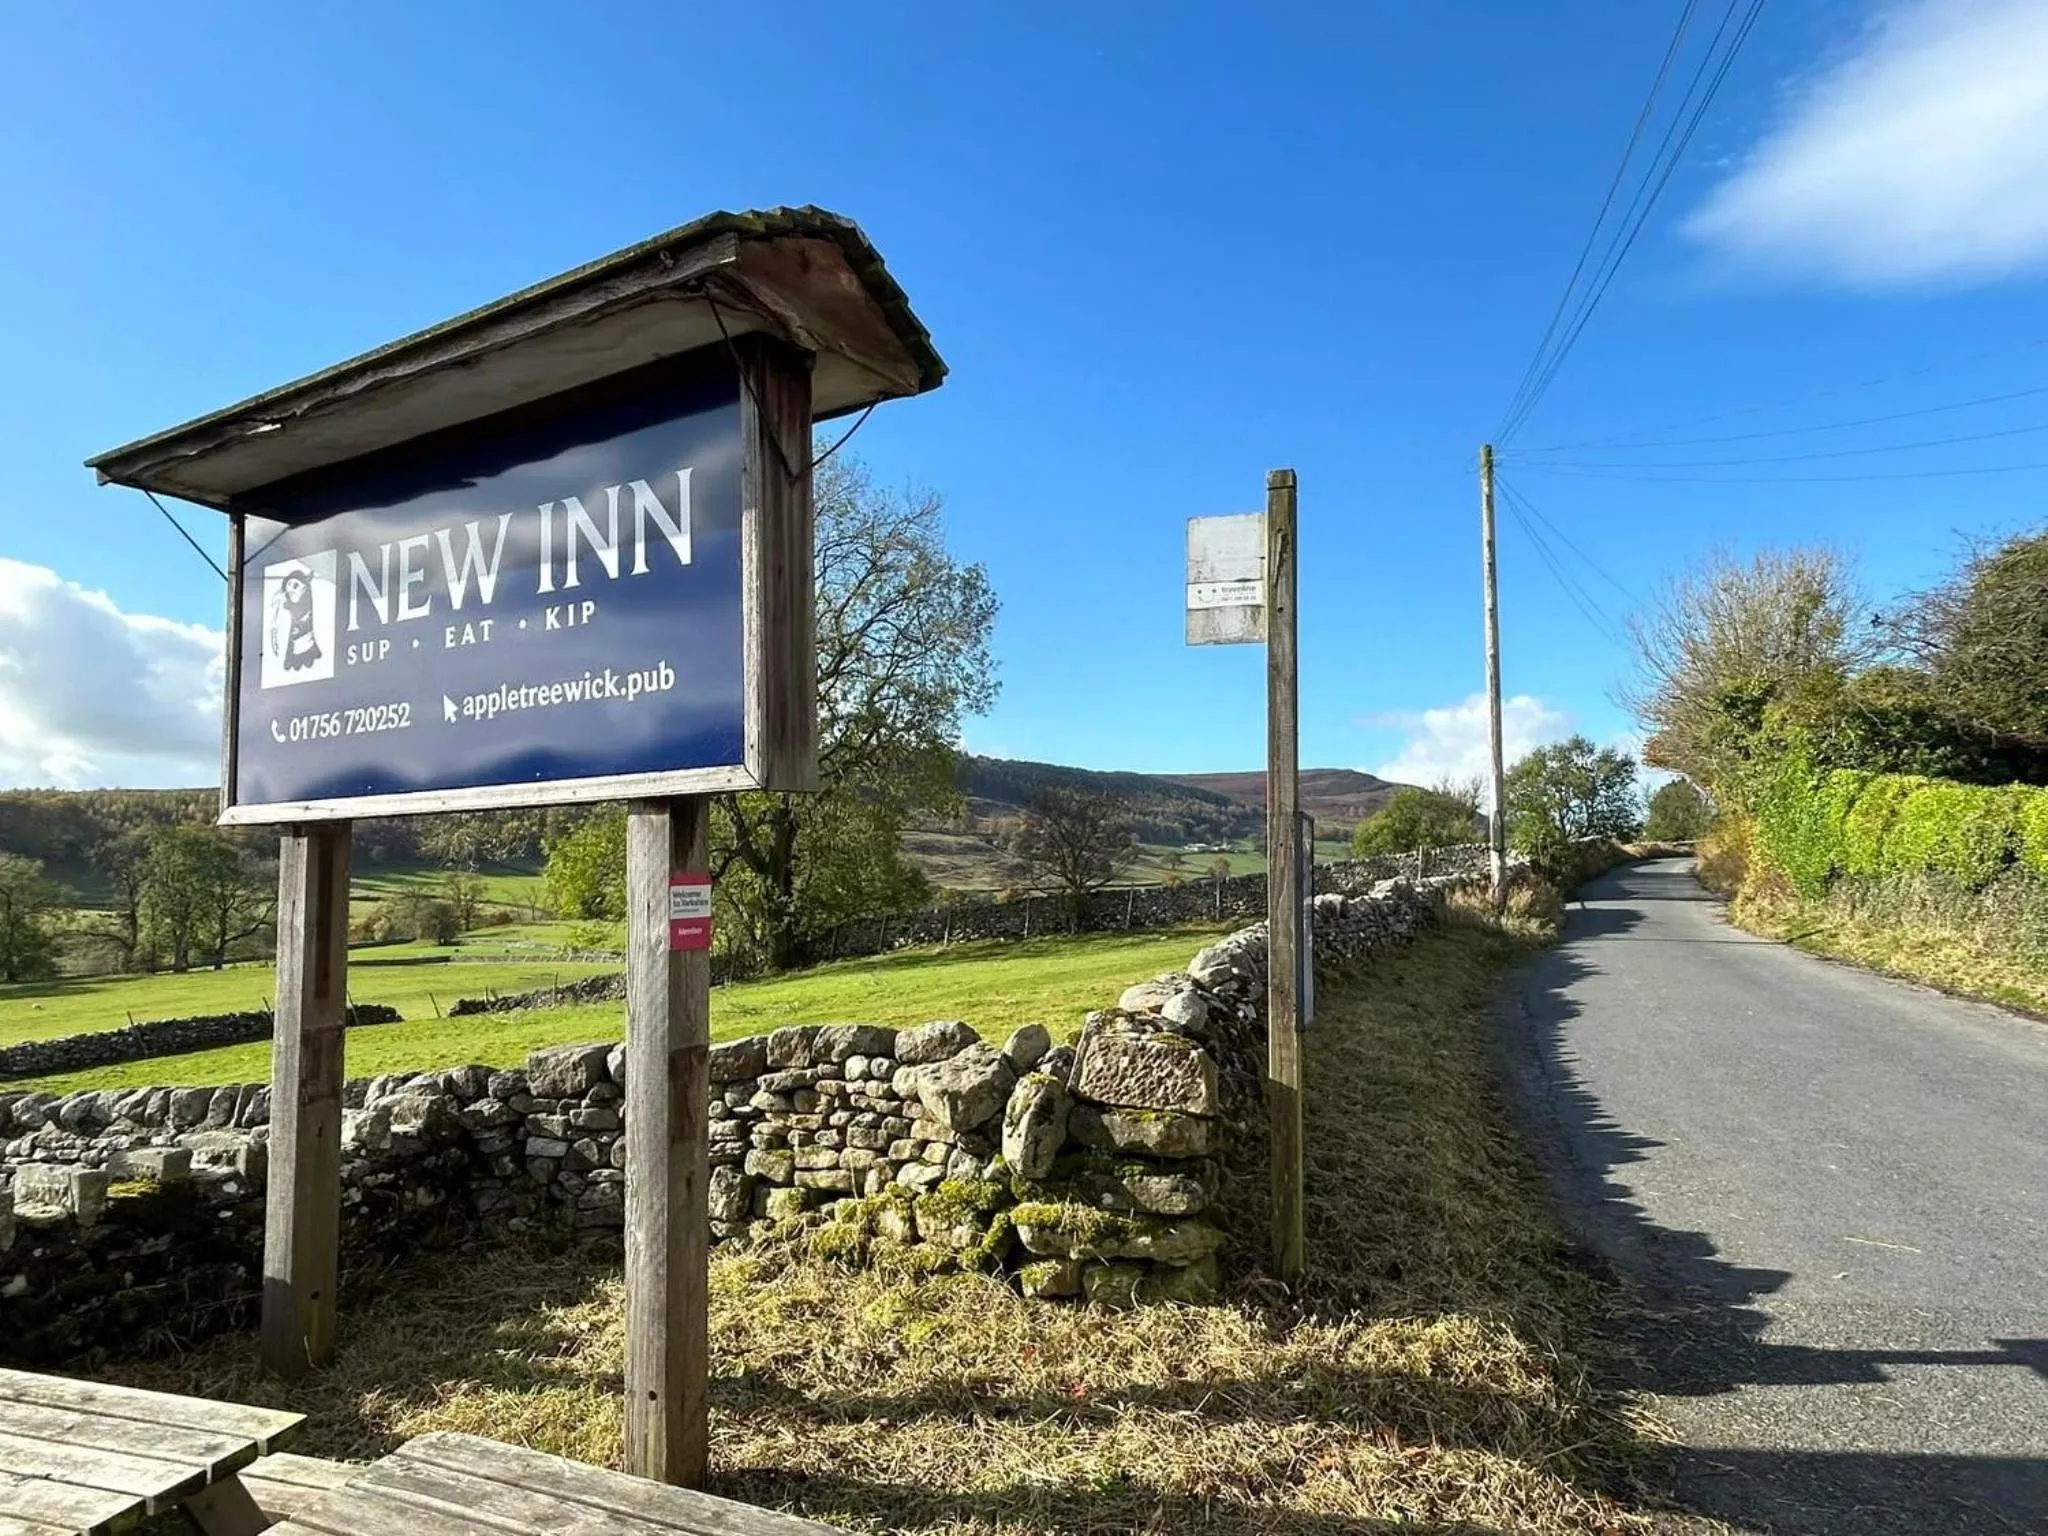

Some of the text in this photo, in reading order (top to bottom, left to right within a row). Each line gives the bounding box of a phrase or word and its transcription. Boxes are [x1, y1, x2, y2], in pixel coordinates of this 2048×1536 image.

[347, 467, 695, 632] NEW INN
[347, 600, 596, 665] SUP EAT KIP
[462, 660, 676, 719] appletreewick.pub
[289, 702, 411, 742] 01756 720252
